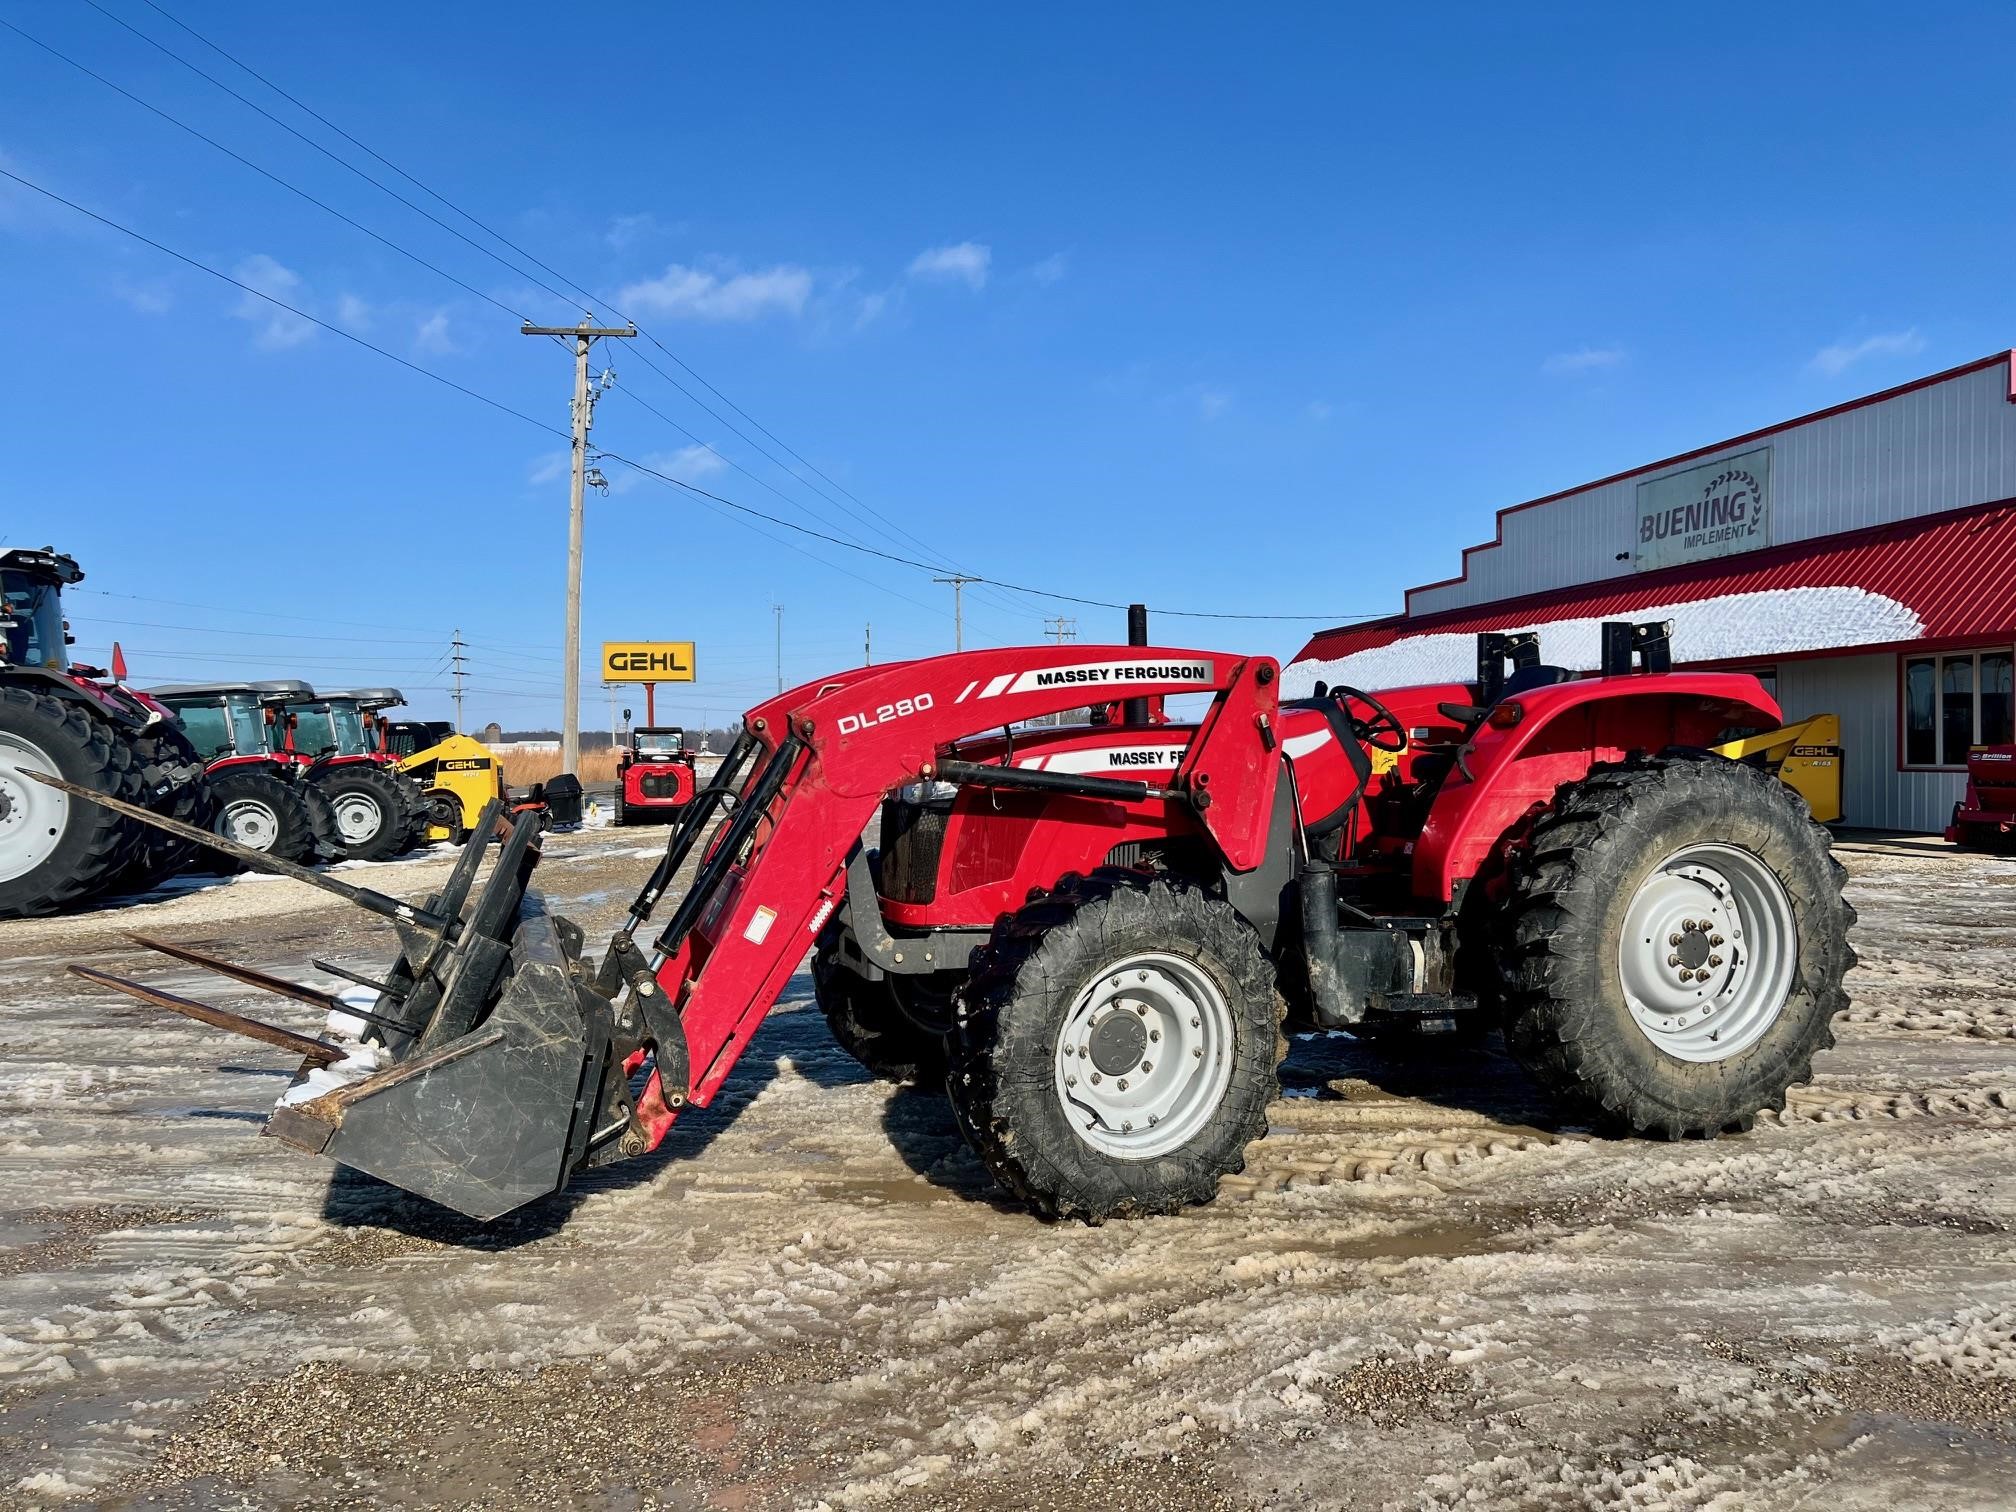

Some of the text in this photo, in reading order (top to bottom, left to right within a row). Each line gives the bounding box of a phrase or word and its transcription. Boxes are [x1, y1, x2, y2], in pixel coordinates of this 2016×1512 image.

[1640, 491, 1746, 544] BUENING
[1684, 523, 1746, 549] IMPLEMENT
[609, 652, 687, 671] GEHL
[1037, 666, 1205, 685] MASSEY FERGUSON
[837, 693, 934, 735] DL280
[1109, 751, 1164, 766] MASSEY
[1794, 747, 1834, 756] GEHL
[445, 761, 480, 770] GEHL
